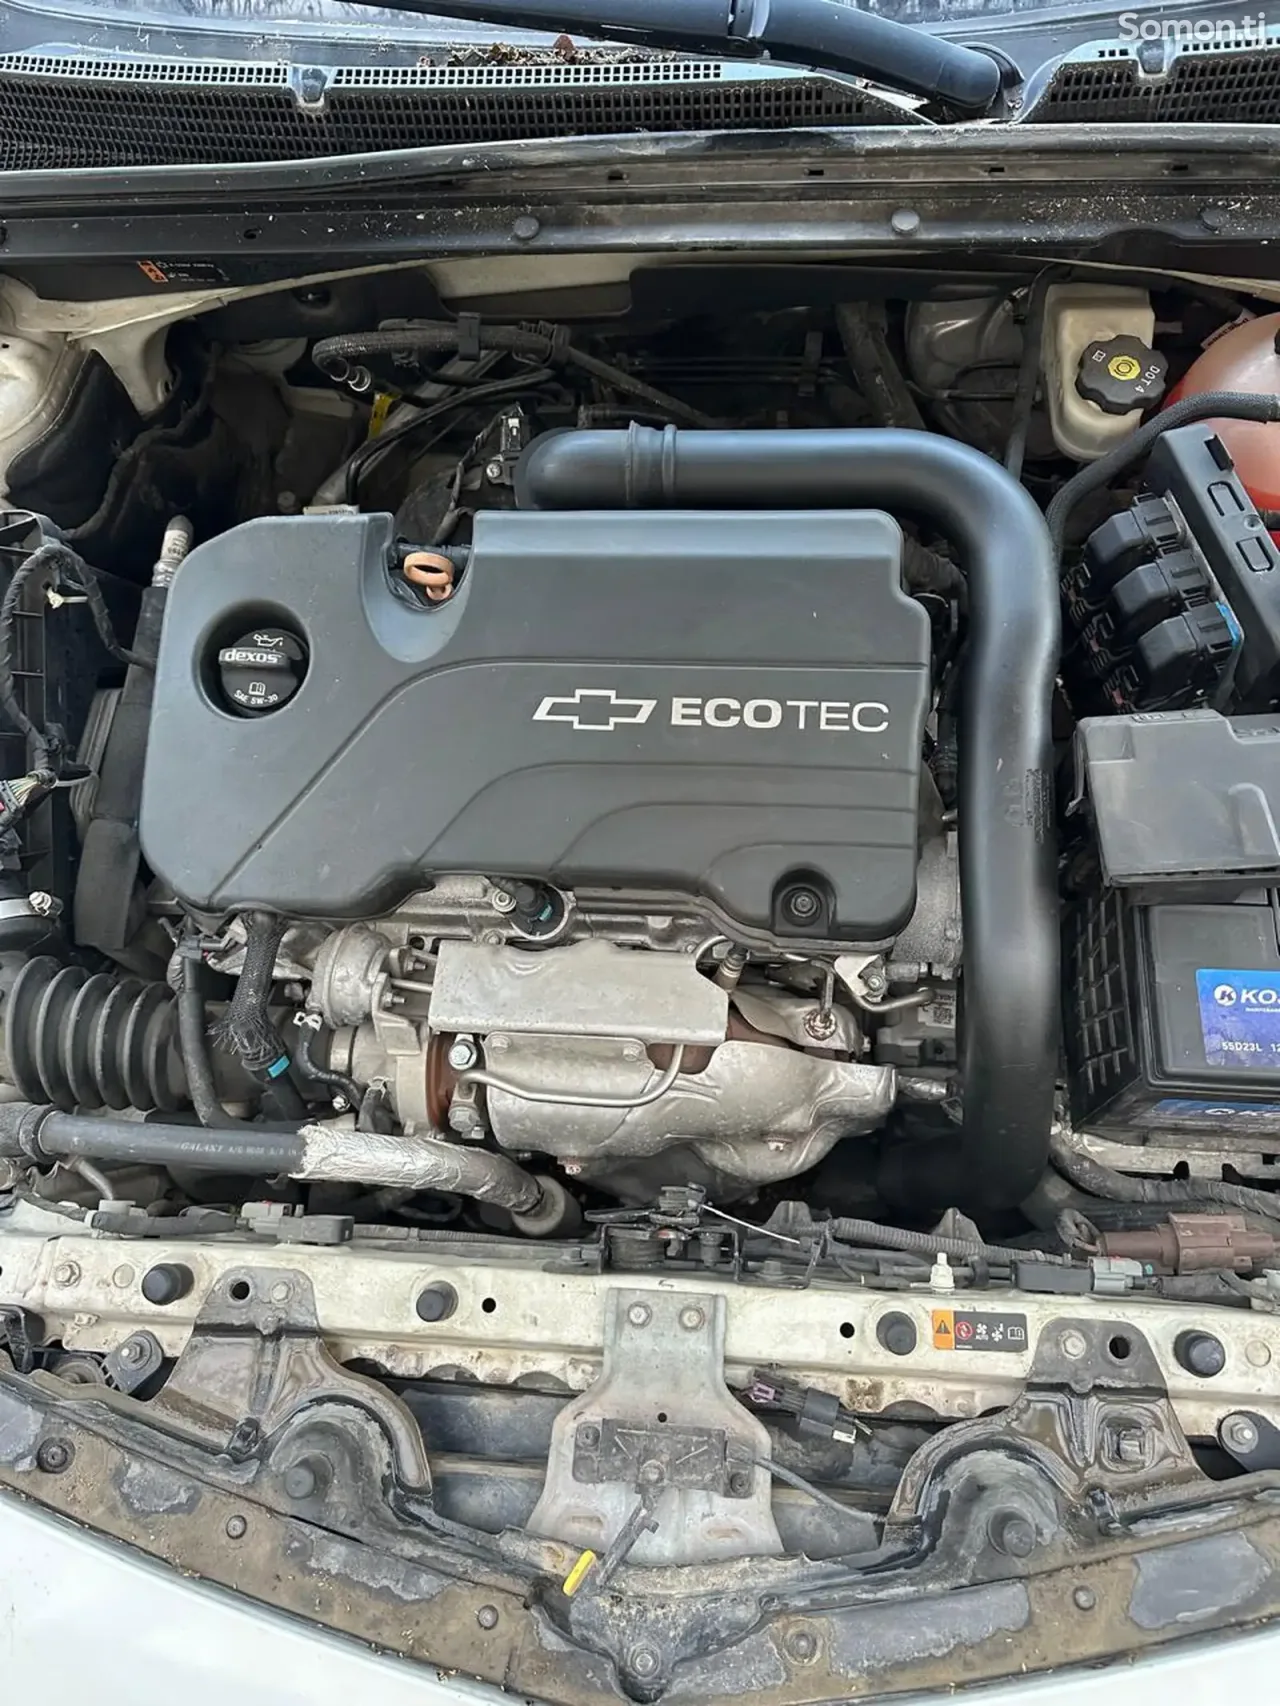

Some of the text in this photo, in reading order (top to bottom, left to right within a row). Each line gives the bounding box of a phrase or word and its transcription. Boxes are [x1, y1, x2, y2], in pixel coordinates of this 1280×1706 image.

[1135, 365, 1161, 394] DOT 4
[224, 648, 282, 664] dexos
[234, 690, 278, 705] SAE 5W-30
[670, 697, 890, 732] ECOTEC
[1240, 988, 1280, 1005] KO
[1222, 1041, 1263, 1053] 55D23L
